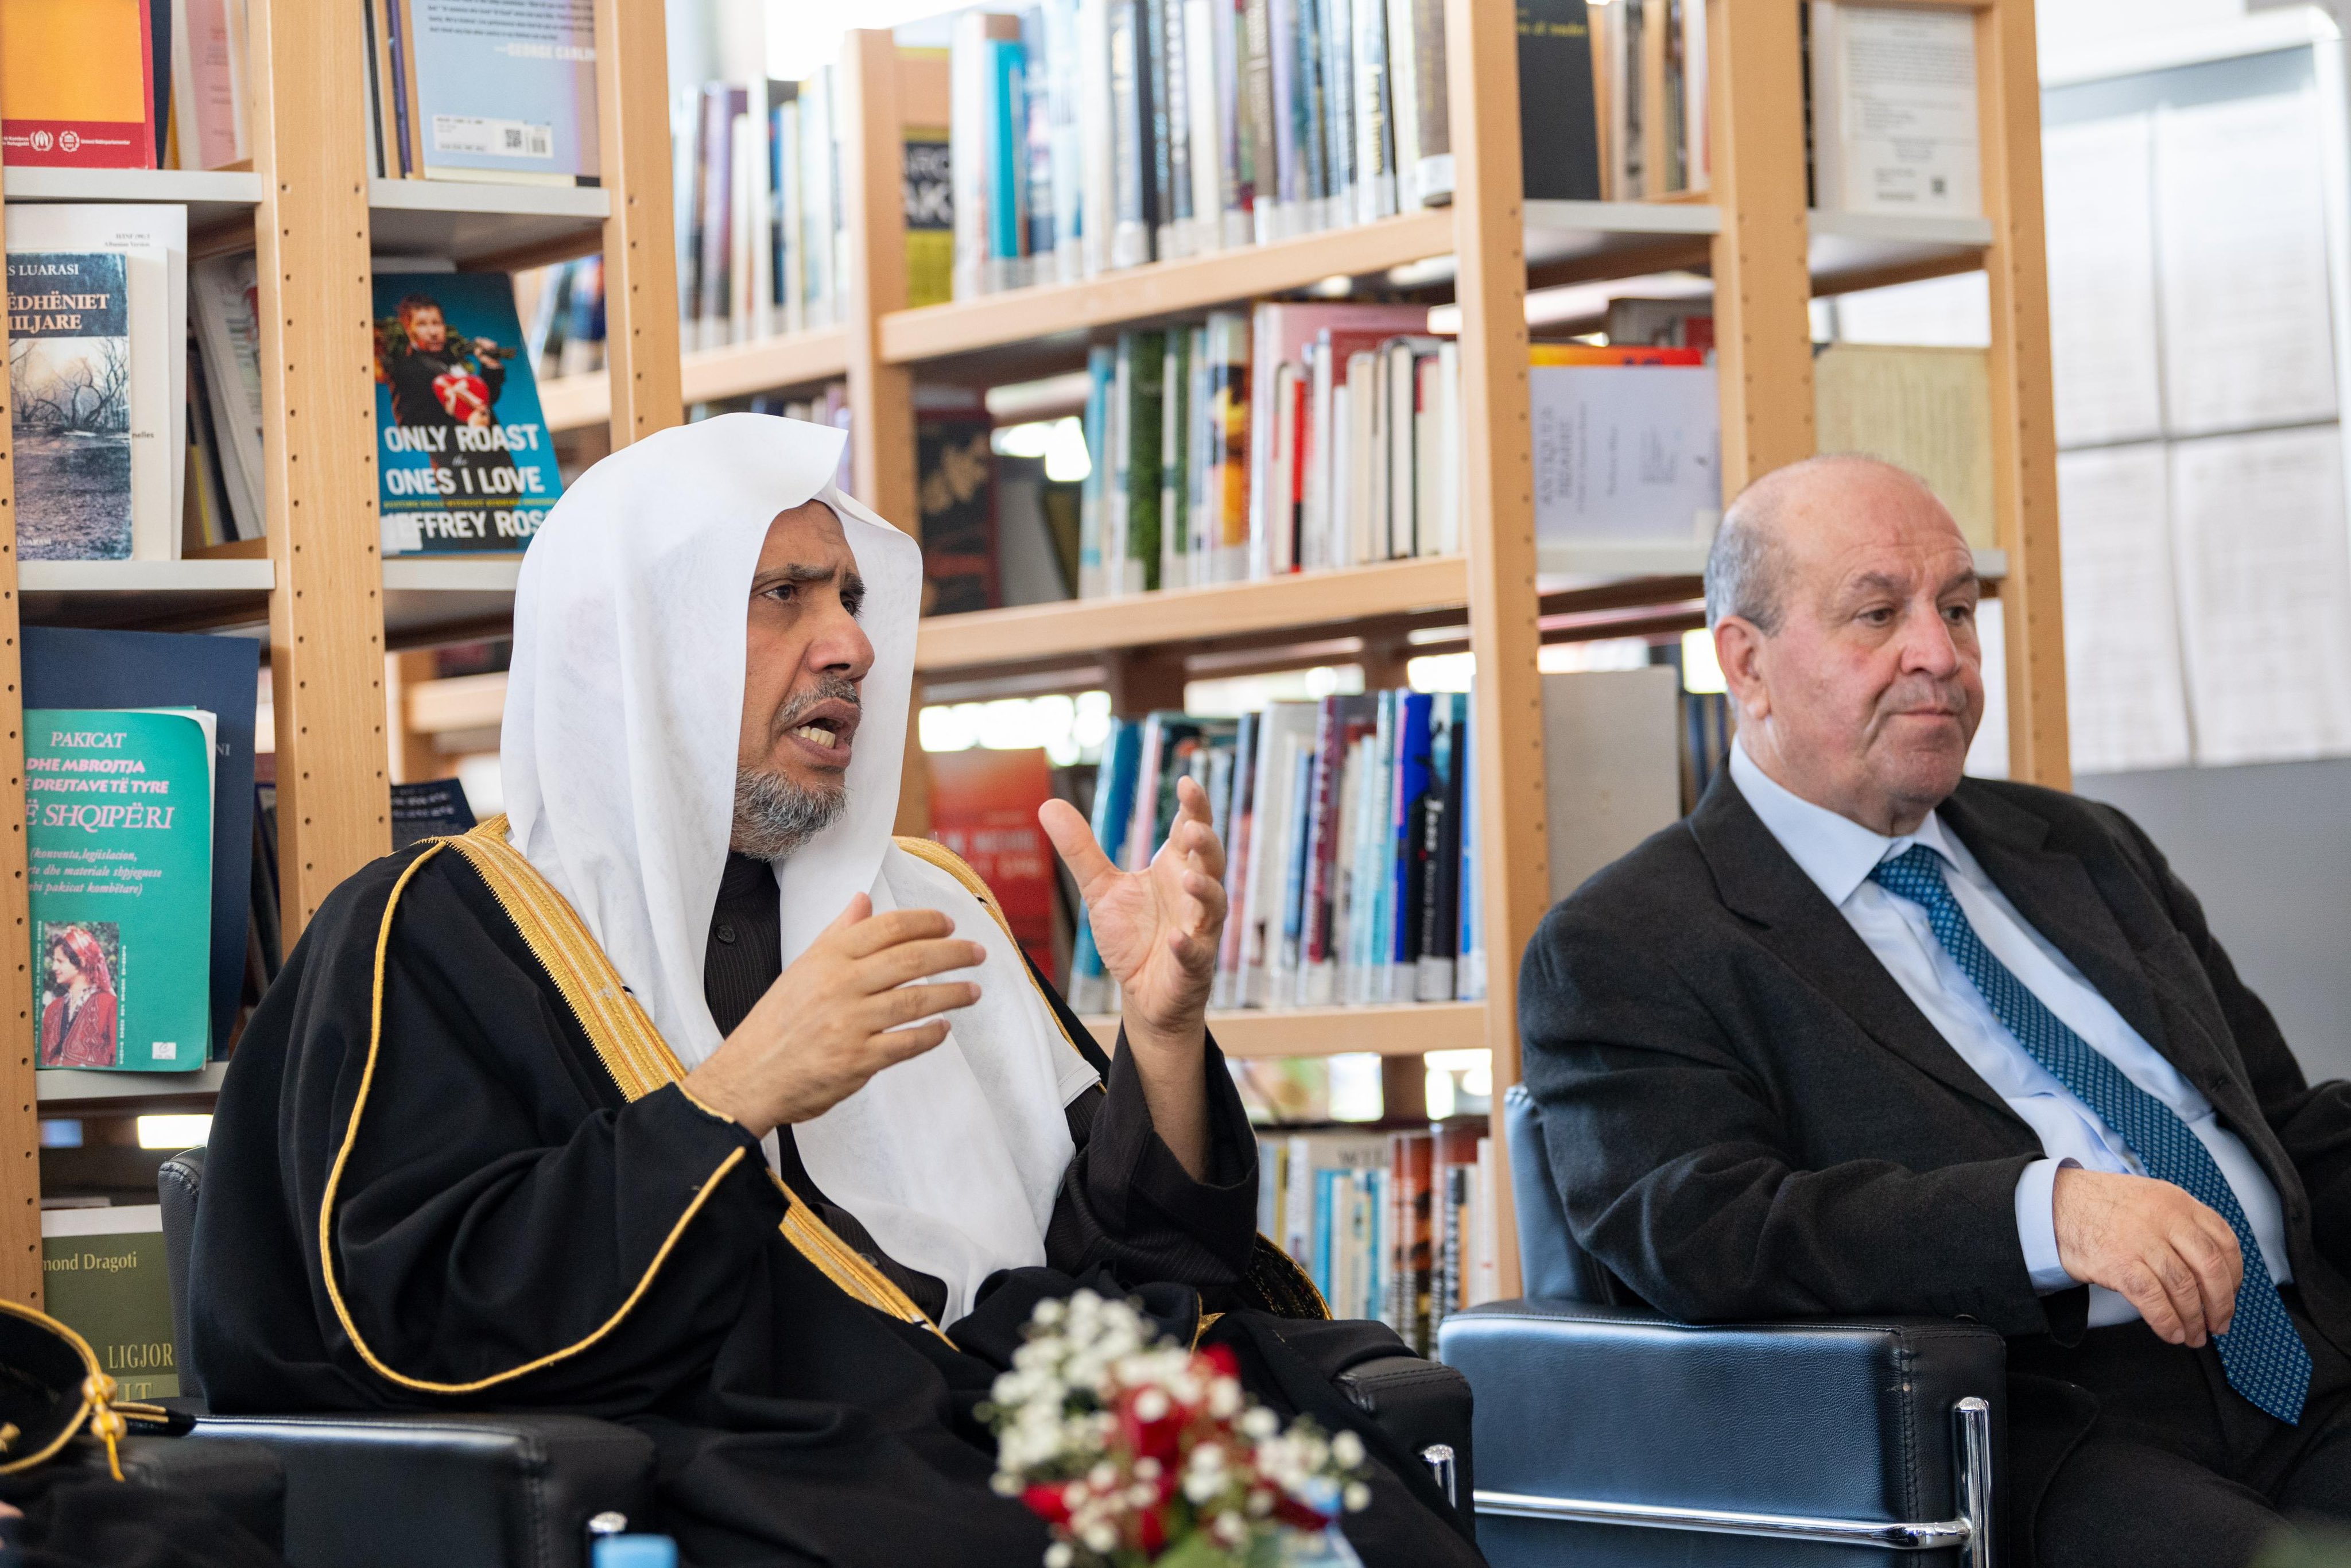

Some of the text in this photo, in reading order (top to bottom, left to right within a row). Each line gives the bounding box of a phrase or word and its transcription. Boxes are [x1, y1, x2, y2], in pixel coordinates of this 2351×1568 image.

[9, 264, 79, 276] S LUARASI
[7, 291, 110, 311] ËDHËNIET
[385, 424, 540, 452] ONLY ROAST
[386, 466, 545, 495] ONES I LOVE
[493, 510, 553, 538] ROS
[51, 732, 127, 748] PAKICAT
[26, 758, 146, 774] DHE MBROJTJA
[32, 778, 108, 793] DREJTAVE
[110, 778, 129, 793] TË
[131, 781, 170, 794] TYRE
[42, 802, 175, 832] SHQIPËRI
[84, 1251, 137, 1273] Dragoti
[108, 1343, 173, 1369] LIGJOR
